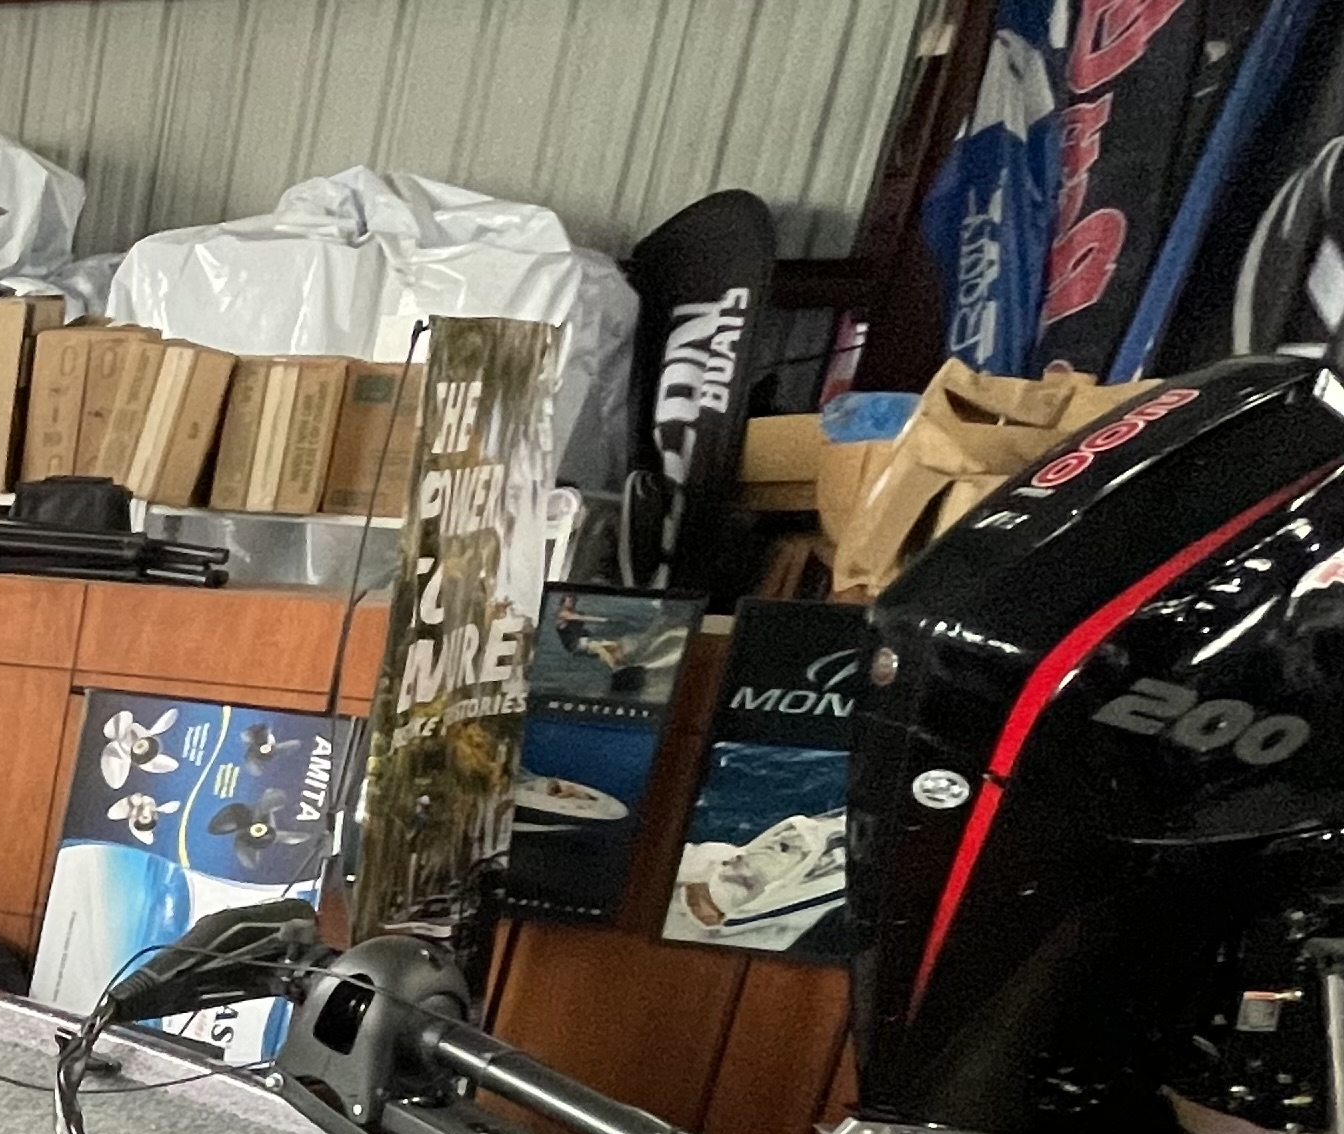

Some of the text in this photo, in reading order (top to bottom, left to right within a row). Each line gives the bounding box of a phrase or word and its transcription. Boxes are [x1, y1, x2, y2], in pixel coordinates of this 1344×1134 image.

[431, 381, 483, 454] THE
[1091, 677, 1311, 765] 200
[296, 735, 334, 822] AMITA
